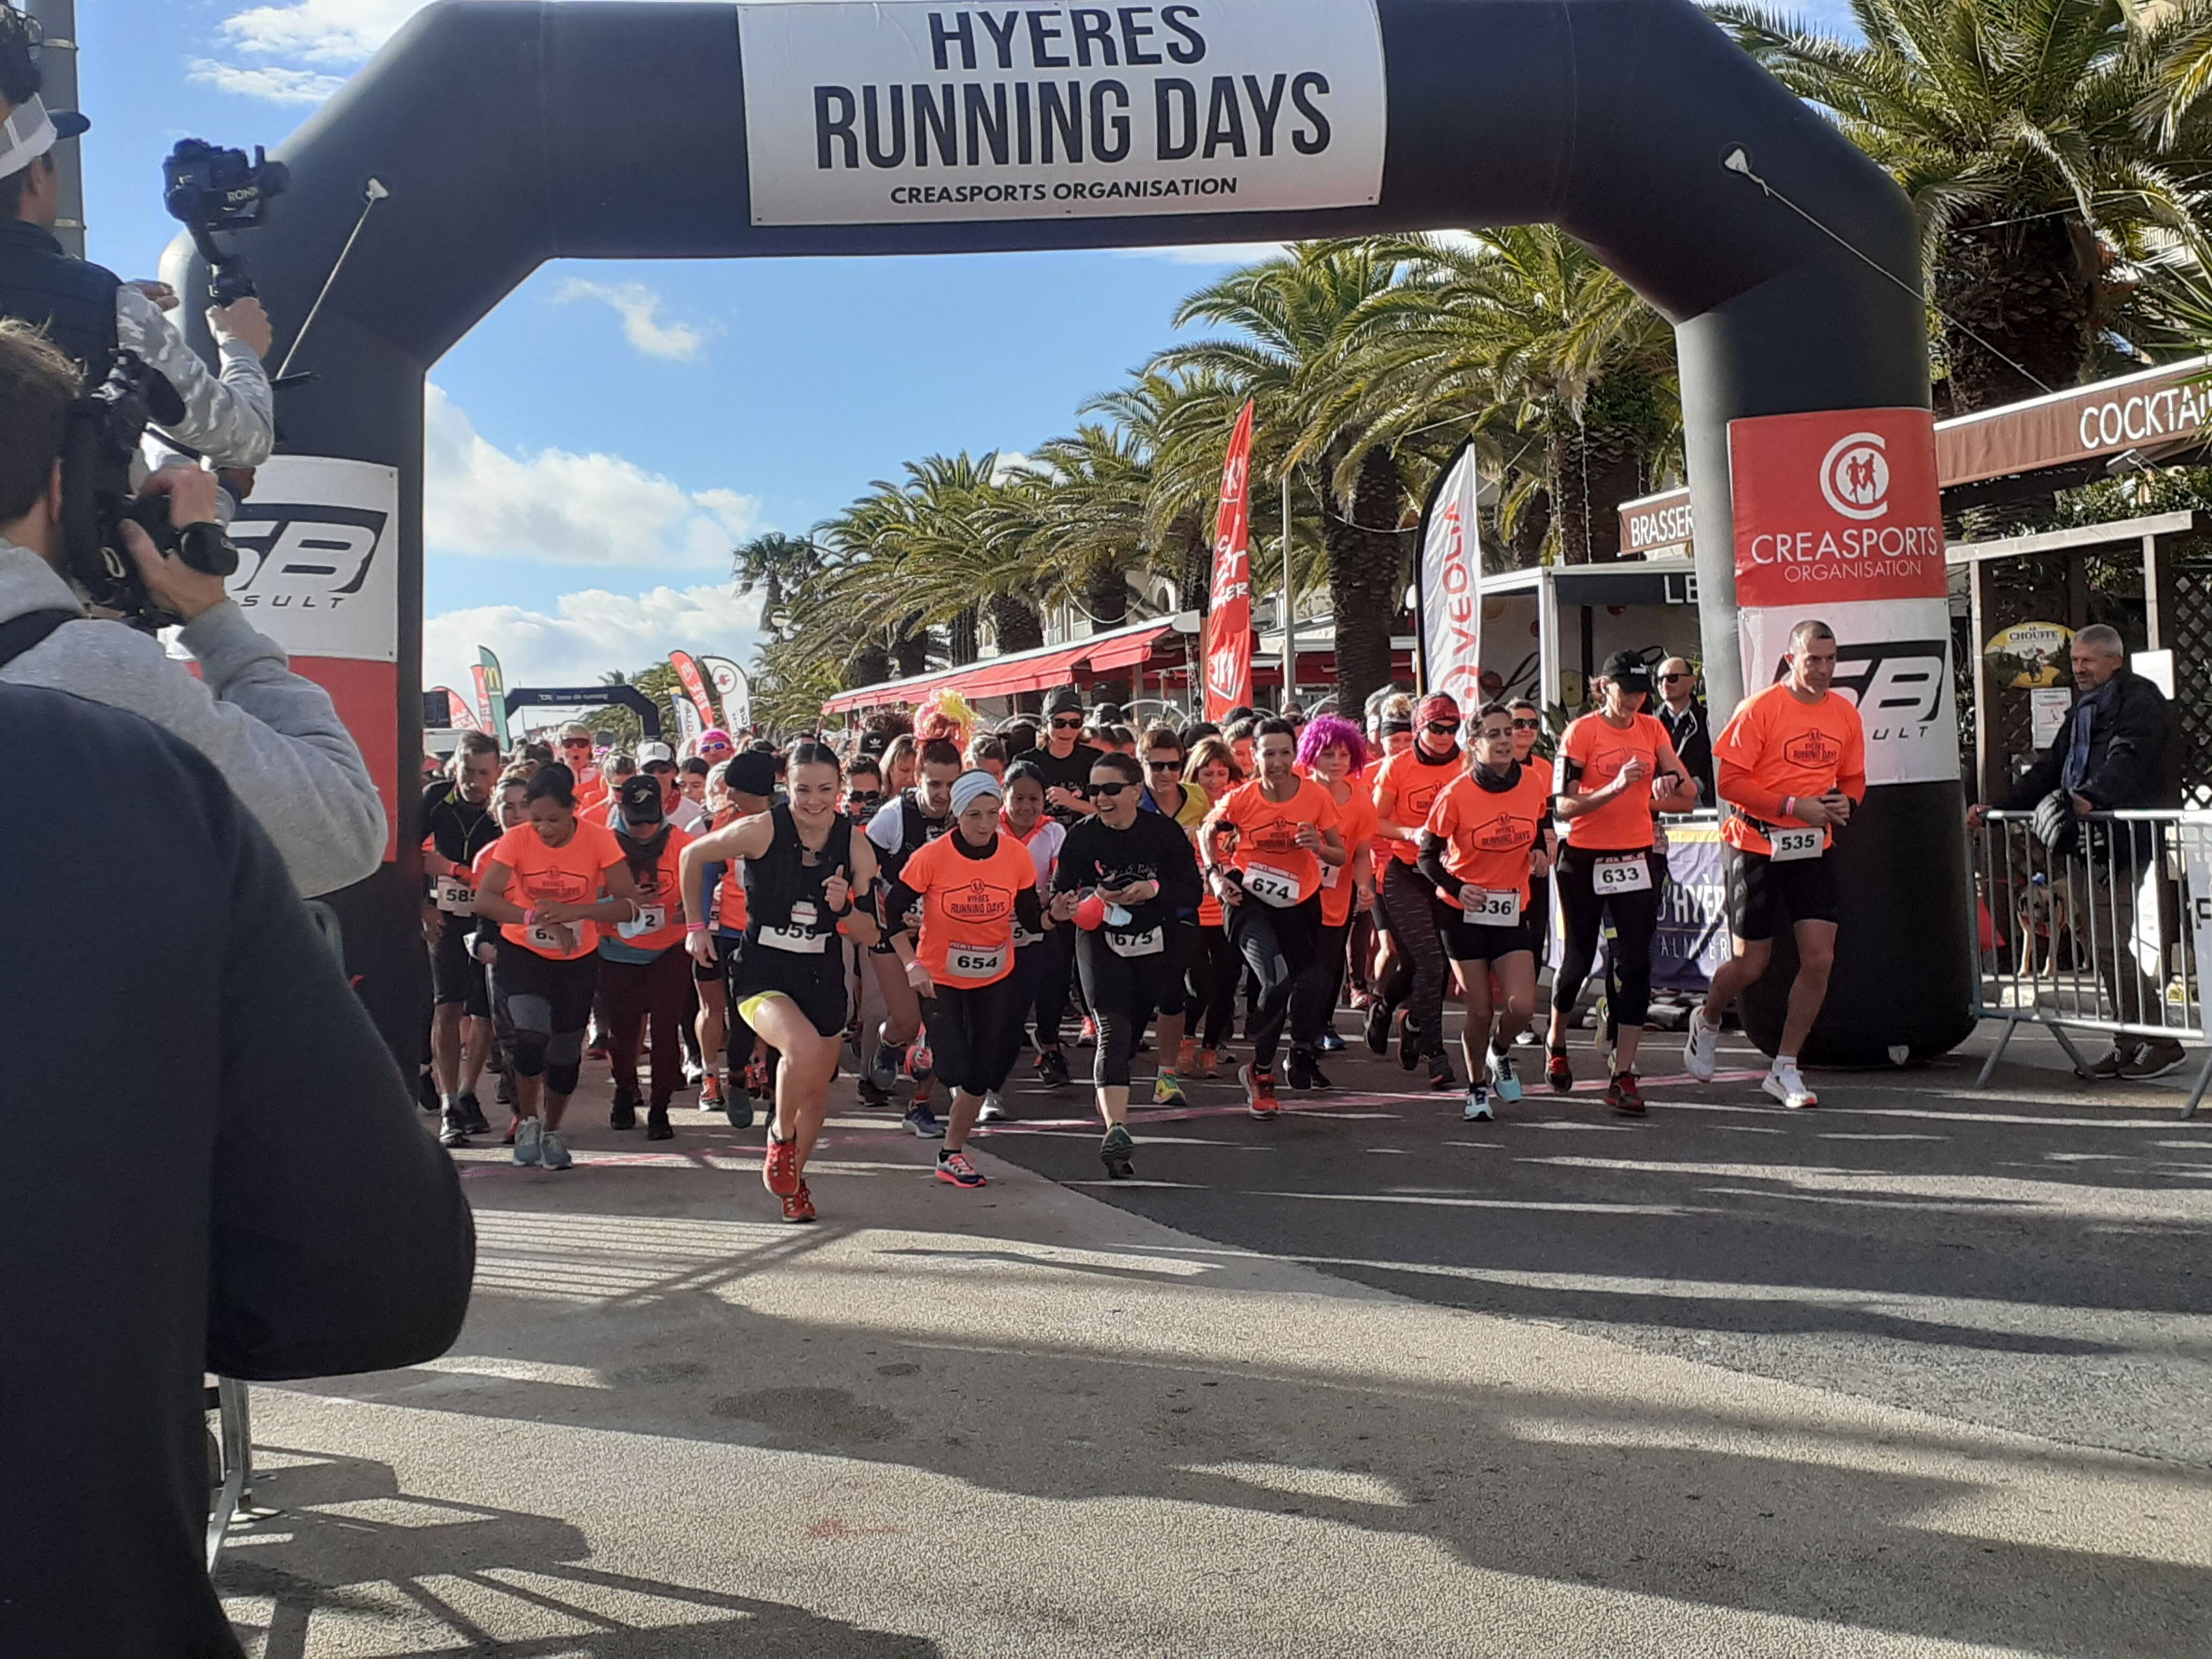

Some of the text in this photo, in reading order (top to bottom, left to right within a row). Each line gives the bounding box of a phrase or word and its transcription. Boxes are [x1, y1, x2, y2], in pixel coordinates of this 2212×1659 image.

[928, 6, 1207, 70] HYERES
[813, 71, 1332, 169] RUNNING DAYS
[890, 177, 1237, 205] CREASPORTS ORGANISATION
[1751, 526, 1937, 564] CREASPORTS
[1444, 500, 1477, 657] VEOLIA
[1784, 560, 1922, 582] ORGANISATION
[240, 595, 345, 609] SULT
[2009, 631, 2059, 640] CHOUFFE
[1872, 727, 1929, 740] ULT
[1781, 834, 1815, 851] 535
[1602, 867, 1639, 884] 633
[1252, 878, 1289, 900] 674
[951, 902, 1005, 914] RUNNING DAYS
[1115, 930, 1153, 946] 675
[957, 955, 998, 969] 654
